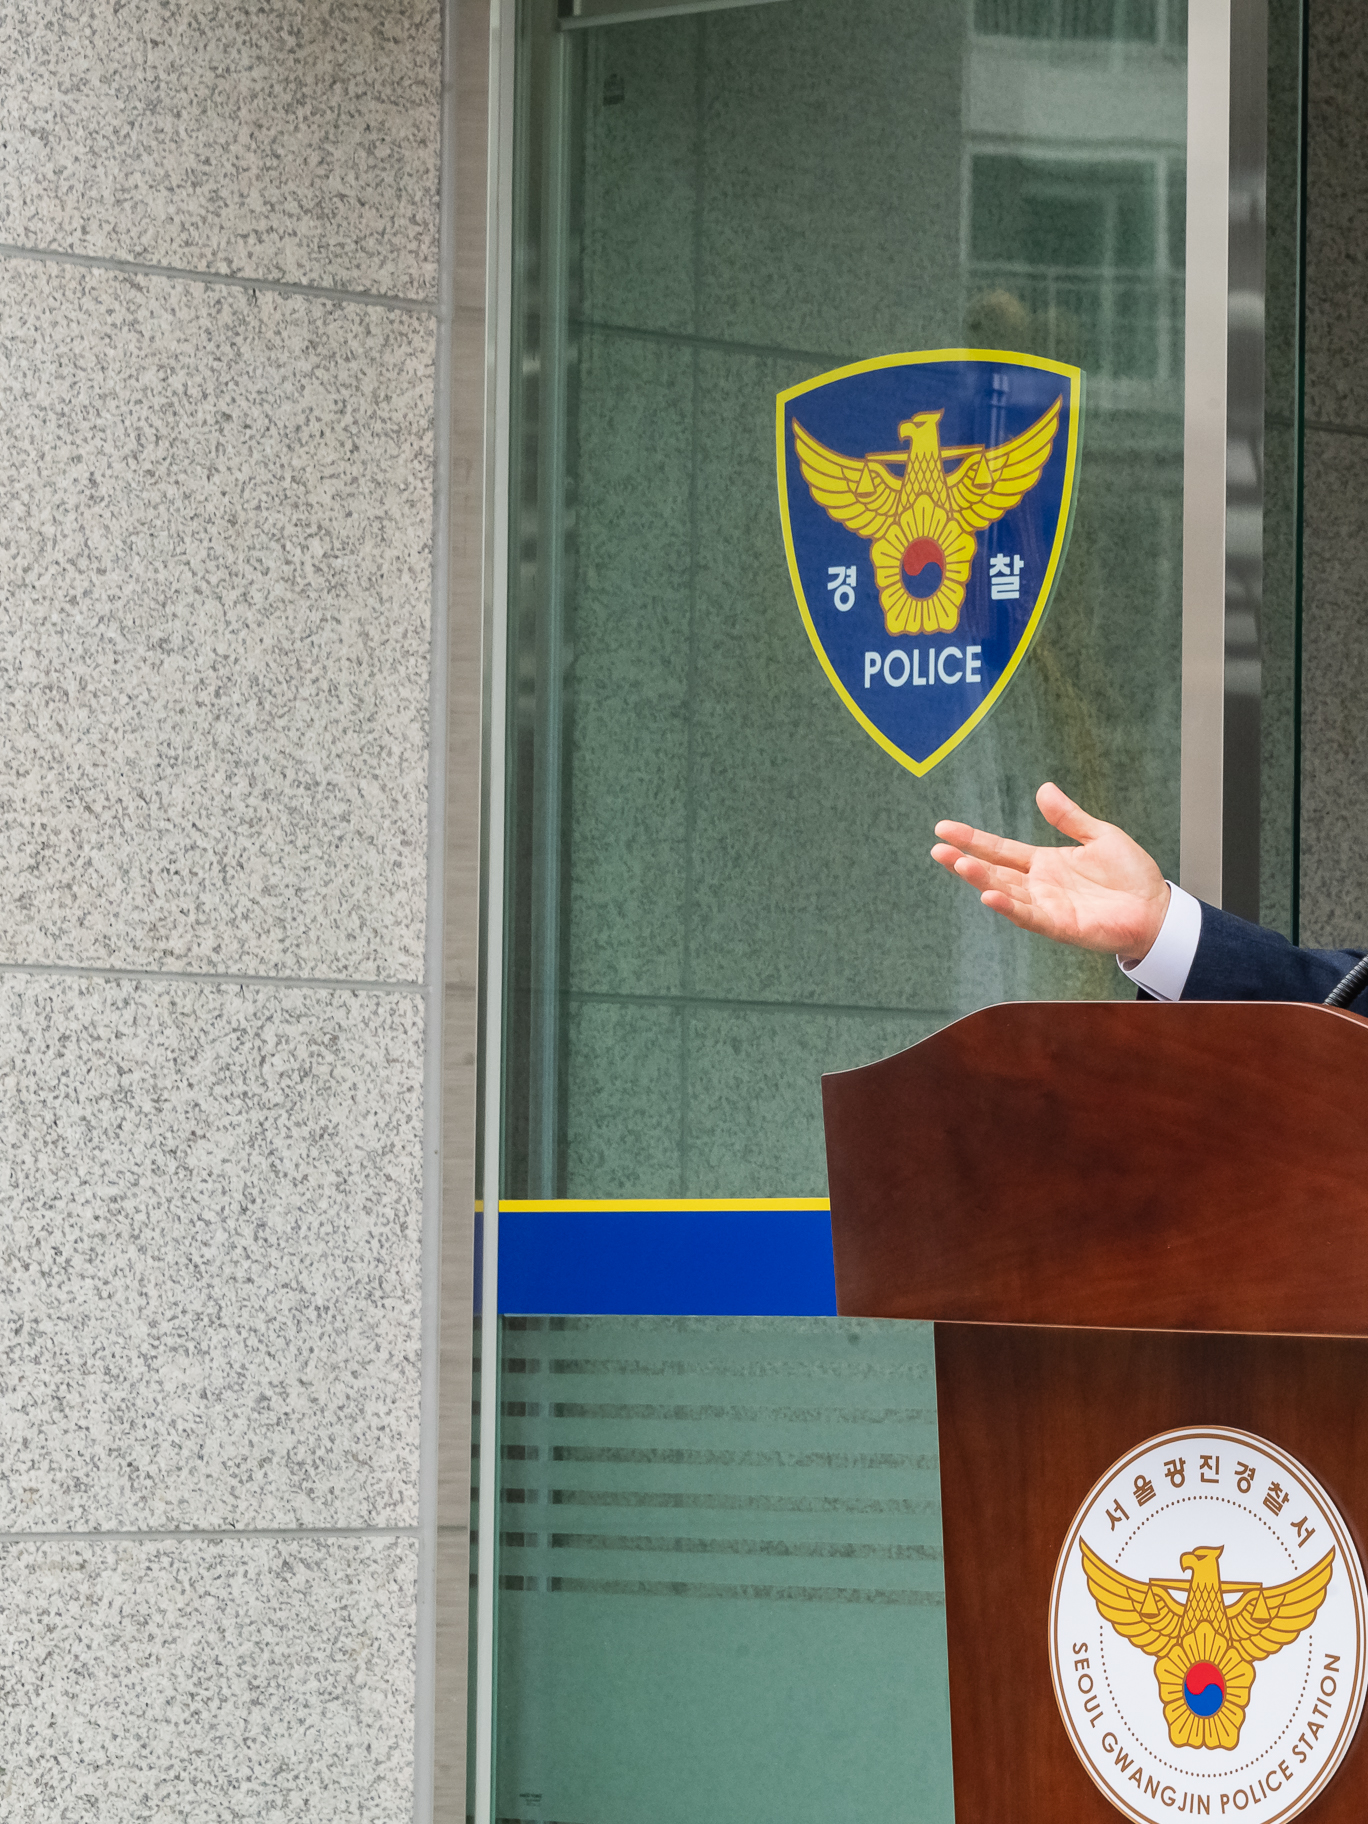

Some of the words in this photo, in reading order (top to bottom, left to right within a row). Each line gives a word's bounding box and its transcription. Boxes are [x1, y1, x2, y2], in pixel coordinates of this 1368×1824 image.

[827, 565, 857, 612] 경
[989, 553, 1024, 600] 찰
[864, 645, 982, 689] POLICE
[1105, 1455, 1317, 1548] 서울광진경찰서
[1073, 1642, 1104, 1728] SEOUL
[1101, 1732, 1210, 1815] GWANGJIN
[1220, 1760, 1294, 1814] POLICE
[1292, 1653, 1341, 1764] STATION
